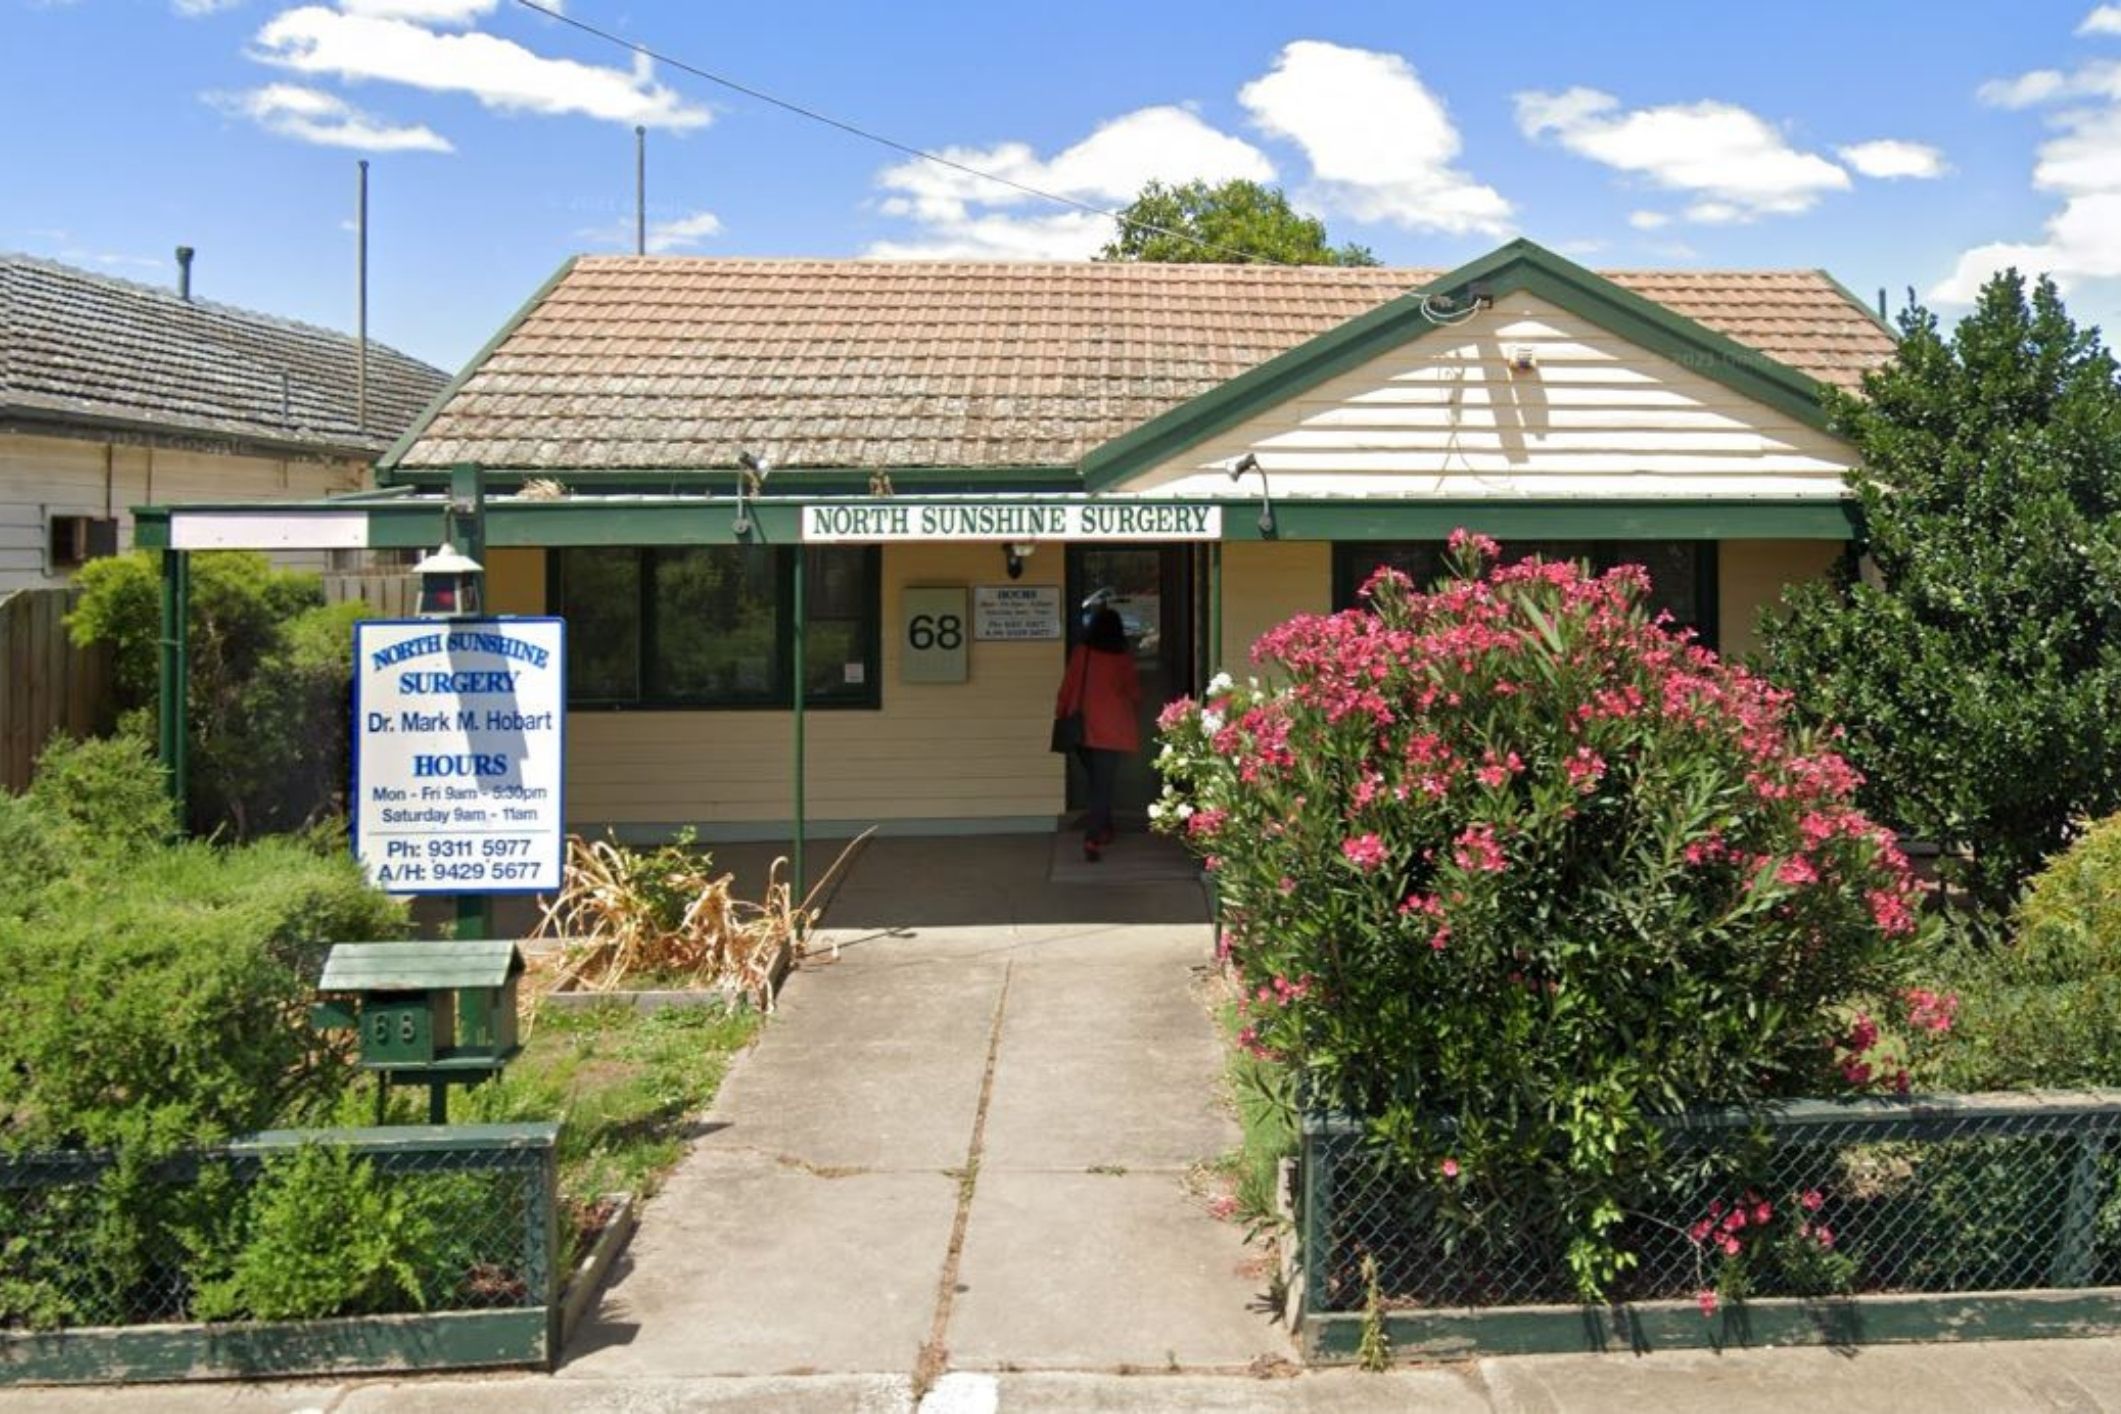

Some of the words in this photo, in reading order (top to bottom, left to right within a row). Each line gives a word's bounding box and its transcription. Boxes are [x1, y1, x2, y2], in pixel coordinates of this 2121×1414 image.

[813, 506, 909, 535] NORTH
[922, 506, 1066, 535] SUNSHINE
[1081, 505, 1211, 533] SURGERY
[909, 614, 963, 651] 68
[372, 634, 442, 671] NORTH
[447, 633, 549, 670] SUNSHINE
[400, 671, 520, 694] SURGERY
[368, 712, 394, 733] Dr.
[401, 712, 450, 732] Mark
[457, 712, 479, 731] M.
[487, 711, 552, 731] Hobart
[413, 754, 508, 777] HOURS
[373, 787, 406, 802] Mon
[422, 787, 441, 801] Fri
[446, 787, 478, 801] 9am
[382, 808, 449, 825] Saturday
[454, 809, 486, 822] 9am
[503, 808, 538, 822] 11am
[387, 840, 421, 859] Ph:
[428, 840, 473, 858] 9311
[482, 839, 532, 858] 5977
[378, 863, 426, 882] A/H:
[433, 863, 484, 881] 9429
[492, 862, 541, 880] 5677
[374, 1011, 415, 1041] 68
